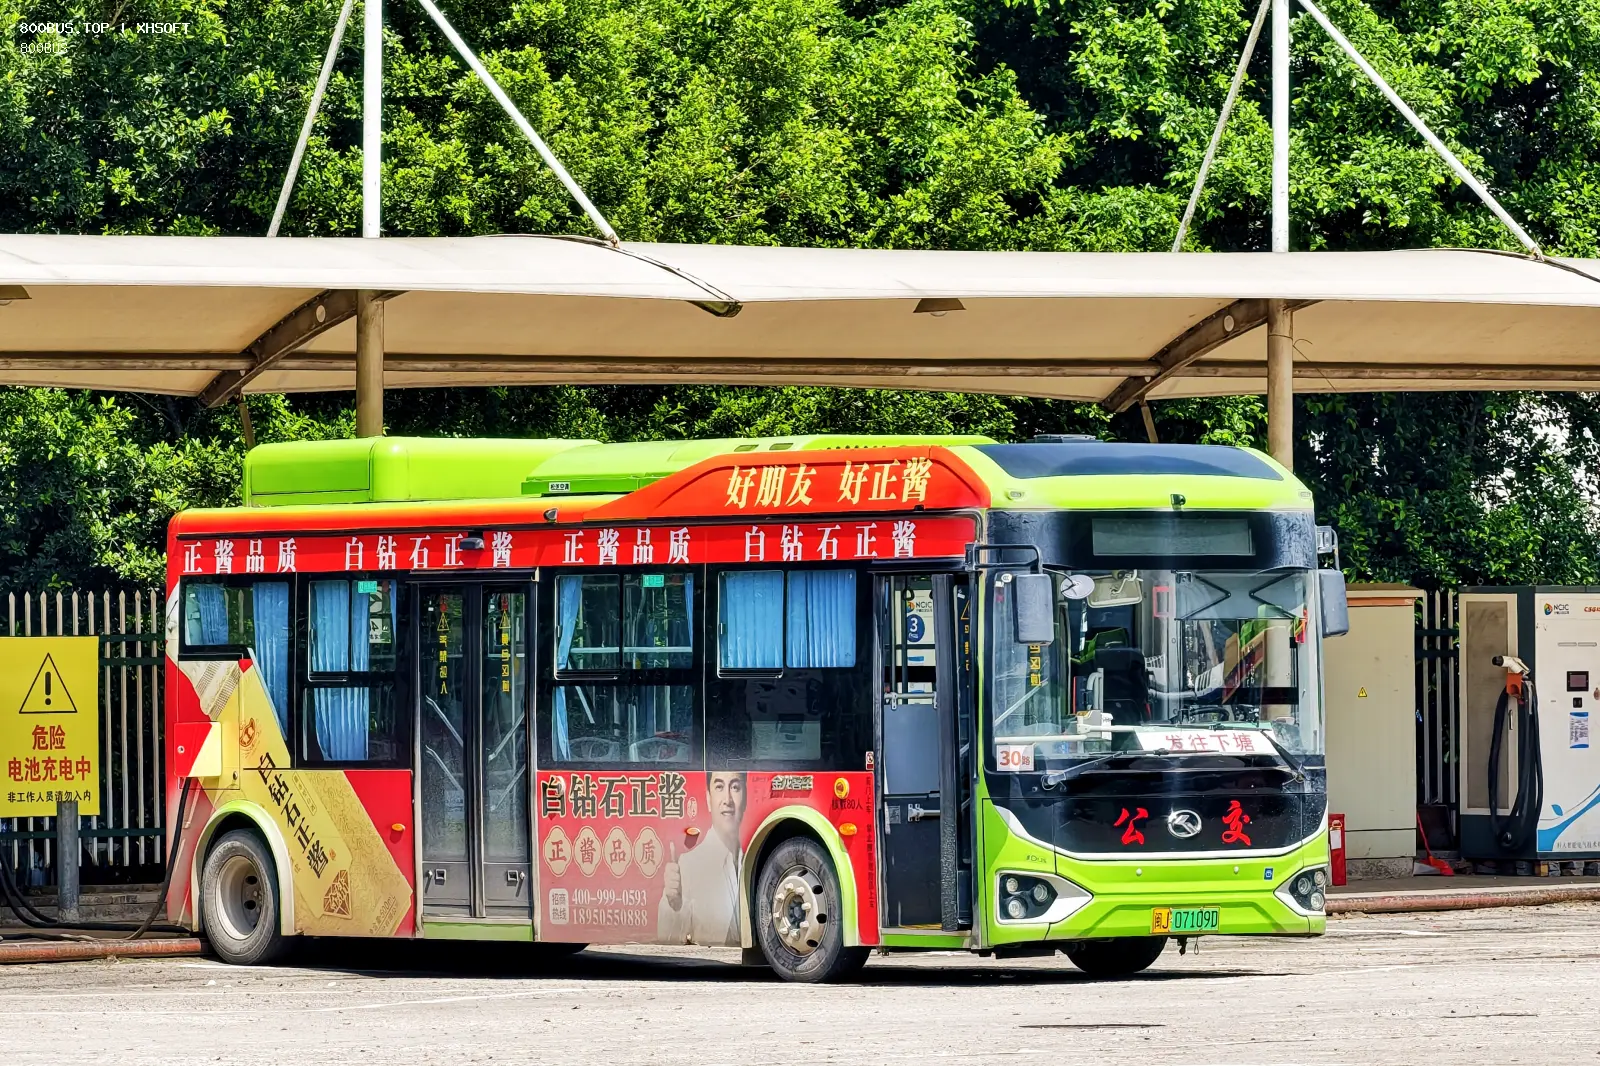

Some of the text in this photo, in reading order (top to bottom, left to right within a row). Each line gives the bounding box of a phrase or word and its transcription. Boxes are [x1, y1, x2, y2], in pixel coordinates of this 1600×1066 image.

[725, 457, 933, 508] 好朋友 好正酱
[183, 520, 917, 574] 正酱品质 白钻石正酱 正酱品质 白钻石正酱
[909, 617, 918, 633] 3
[32, 724, 66, 751] 危险
[1165, 733, 1256, 752] 发往下塘
[8, 755, 91, 782] 电池充电中
[7, 790, 91, 804] 非工作人员请勿入内
[540, 772, 687, 819] 白钻石正酱
[257, 752, 329, 879] 白钻石正酱
[549, 837, 656, 866] 正酱品质
[571, 888, 647, 907] 400-999-0593
[573, 907, 648, 926] 18950550888
